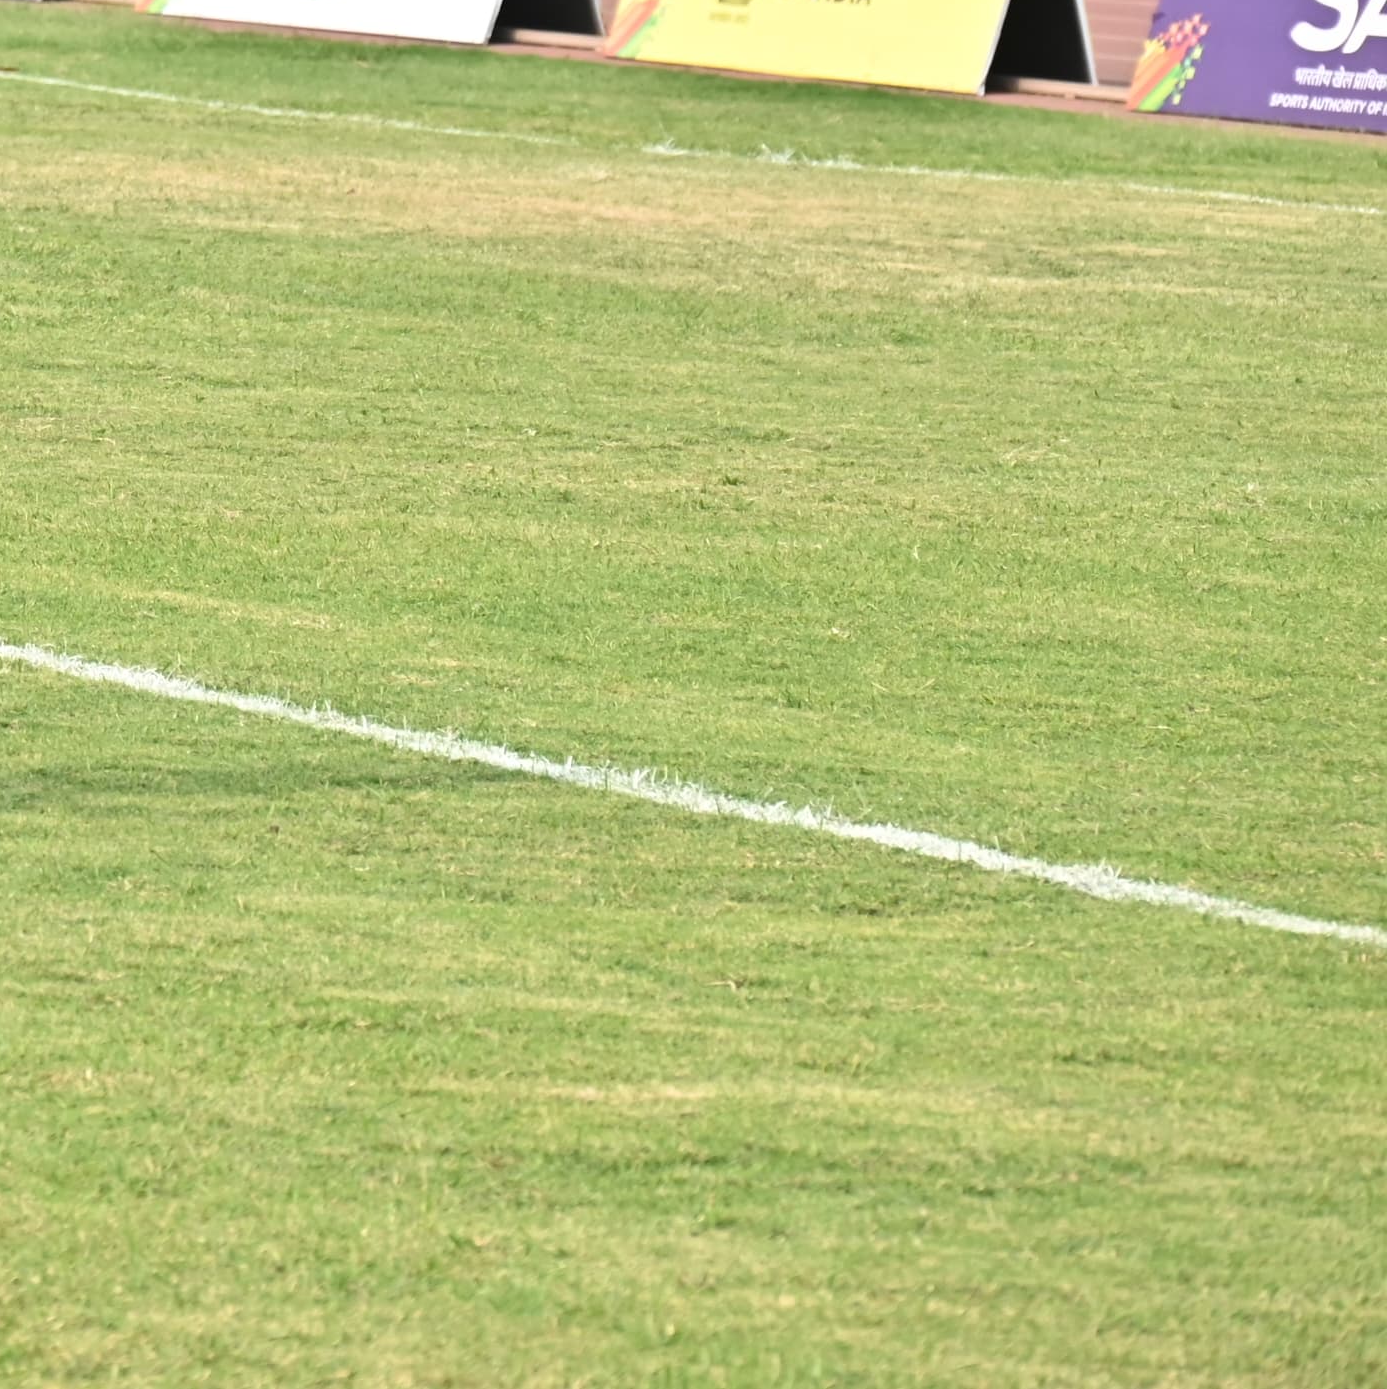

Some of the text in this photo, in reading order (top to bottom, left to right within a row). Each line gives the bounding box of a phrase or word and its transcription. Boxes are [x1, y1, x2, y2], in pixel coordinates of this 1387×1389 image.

[1269, 92, 1309, 110] SPORTS
[1309, 96, 1367, 115] AUTHORITY
[1366, 101, 1383, 116] OF
